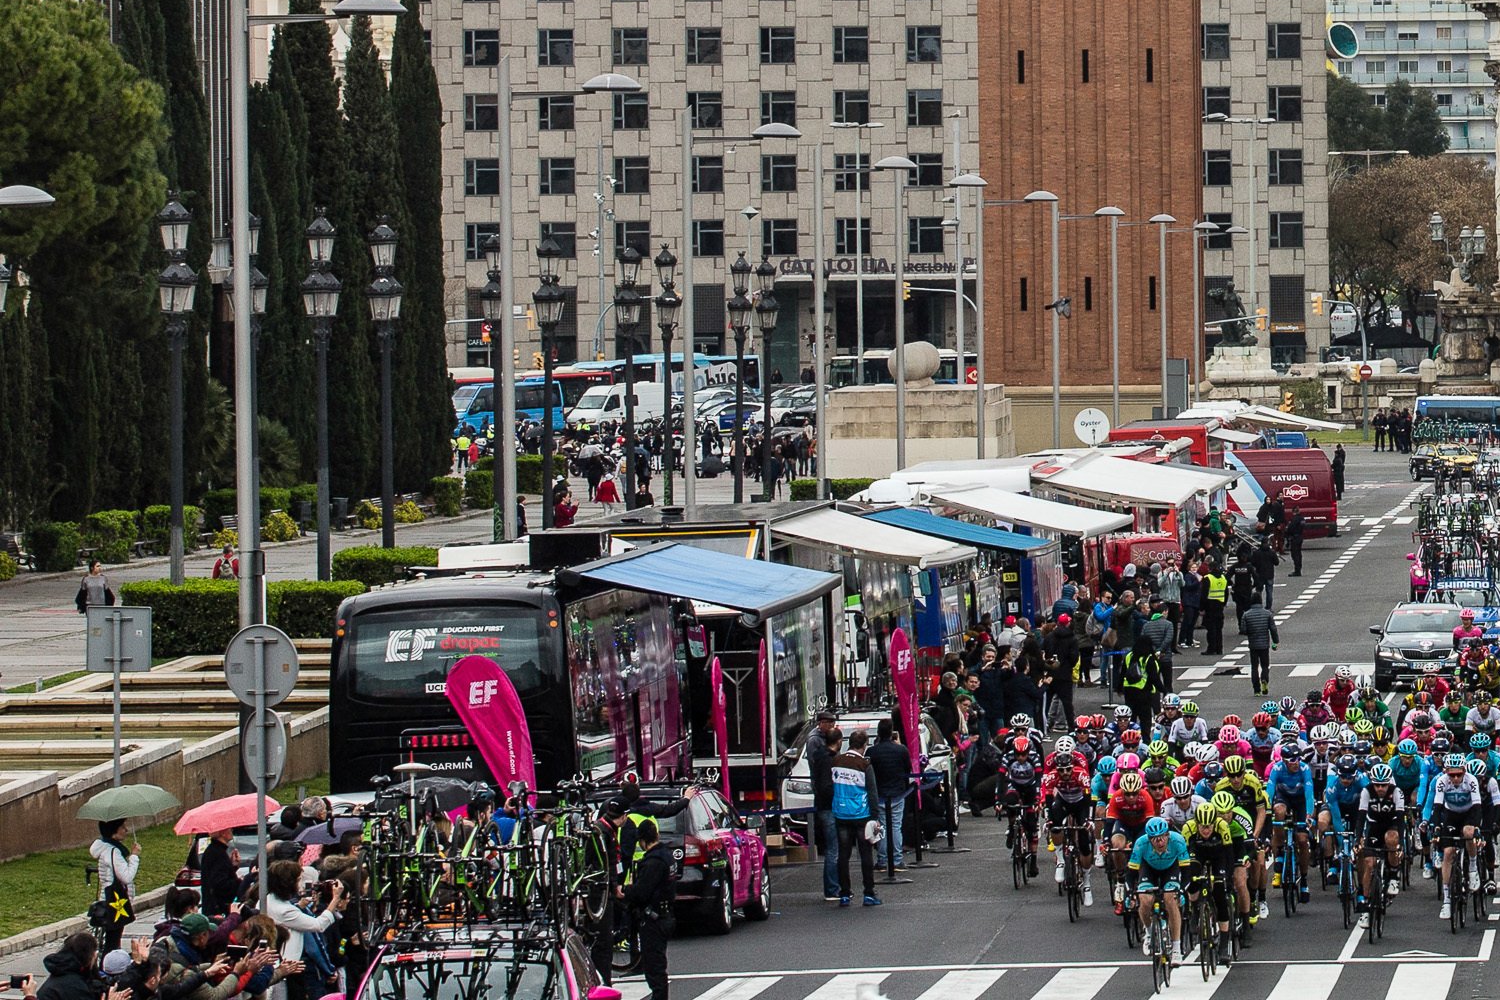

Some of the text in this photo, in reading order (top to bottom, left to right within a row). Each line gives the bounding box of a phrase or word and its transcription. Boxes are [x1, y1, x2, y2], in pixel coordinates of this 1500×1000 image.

[780, 258, 891, 273] CATLONIA
[1080, 420, 1102, 428] Oyster
[1271, 474, 1308, 482] KATUSHA
[1284, 487, 1308, 499] Alpecin
[1148, 550, 1182, 561] Cofidis
[1436, 581, 1490, 590] SHIMANO
[442, 626, 484, 634] EDUCATION
[384, 627, 438, 663] EF
[897, 649, 911, 671] EF
[427, 684, 444, 692] UCI
[468, 680, 498, 705] EF
[505, 730, 516, 775] www.ef.com
[430, 760, 473, 771] GARMIN
